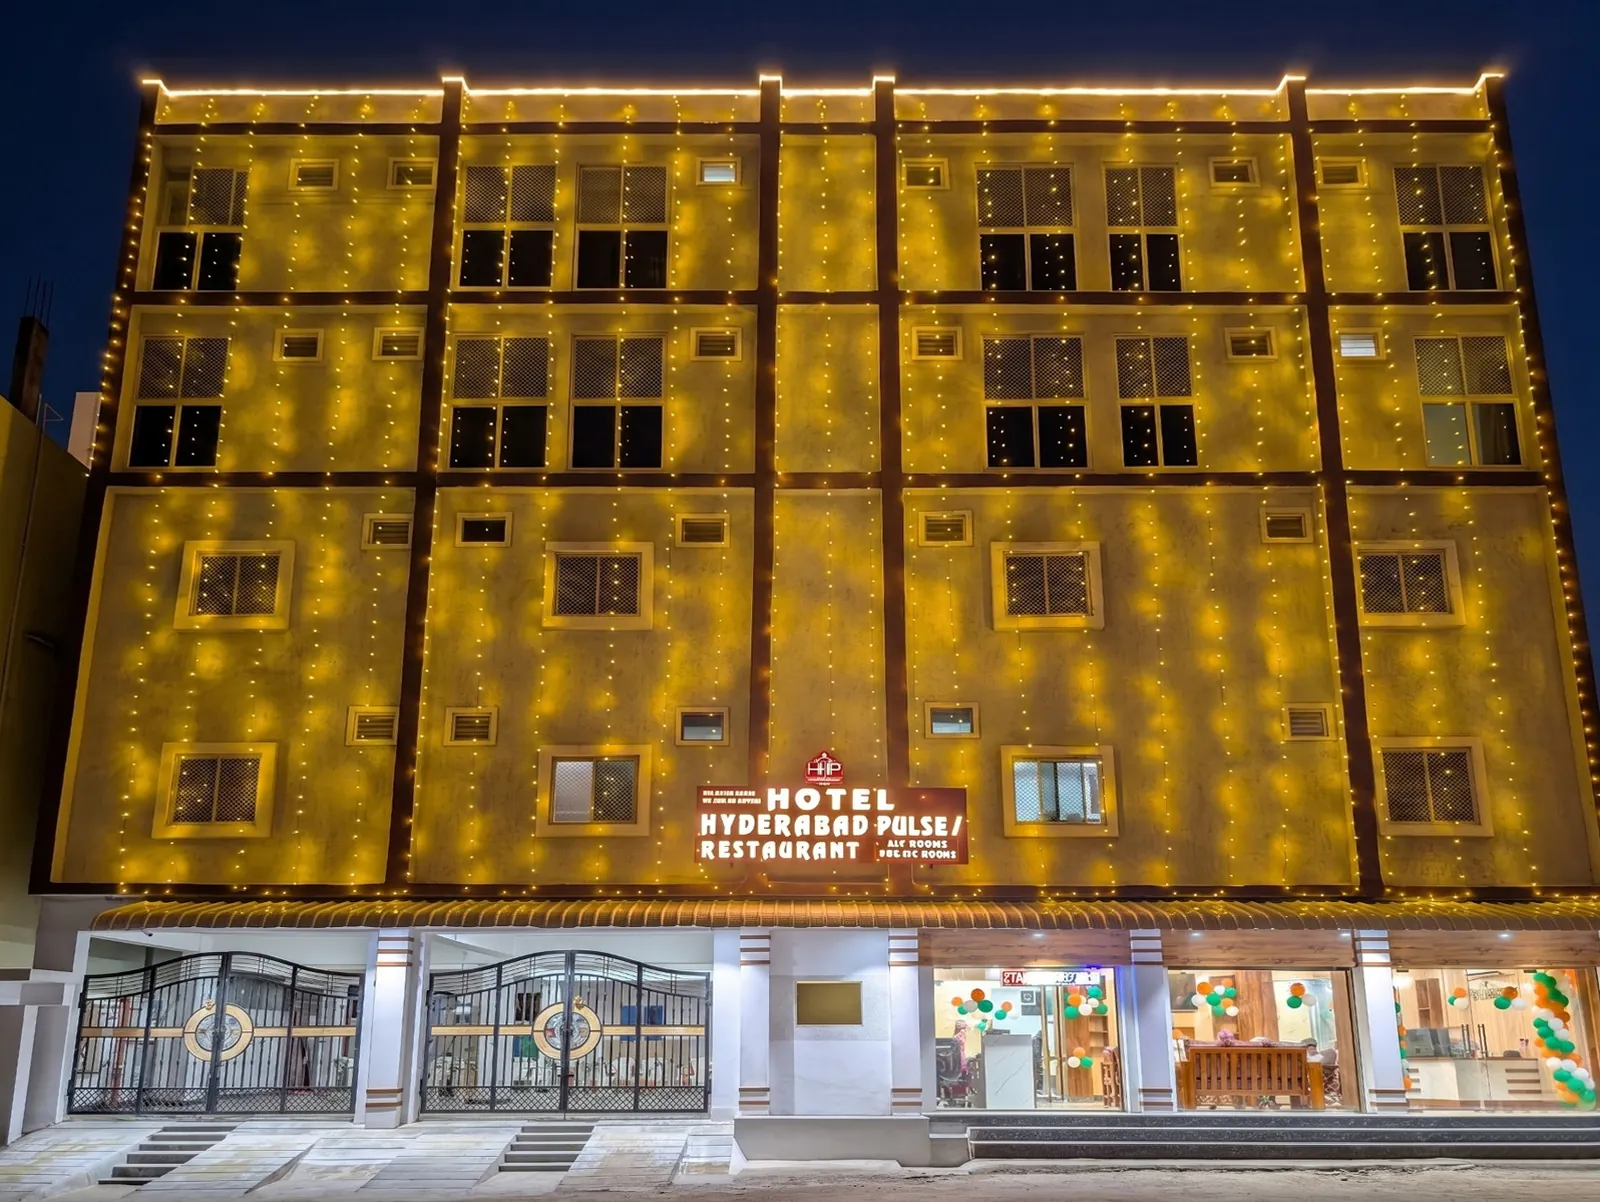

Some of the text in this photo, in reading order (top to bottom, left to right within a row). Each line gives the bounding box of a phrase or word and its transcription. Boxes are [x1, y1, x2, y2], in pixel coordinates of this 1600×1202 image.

[767, 788, 895, 811] HOTEL
[701, 813, 868, 837] HYDERABAD
[701, 840, 859, 860] RESTAURANT
[909, 840, 948, 848] ROOMS
[921, 850, 957, 858] ROOMS
